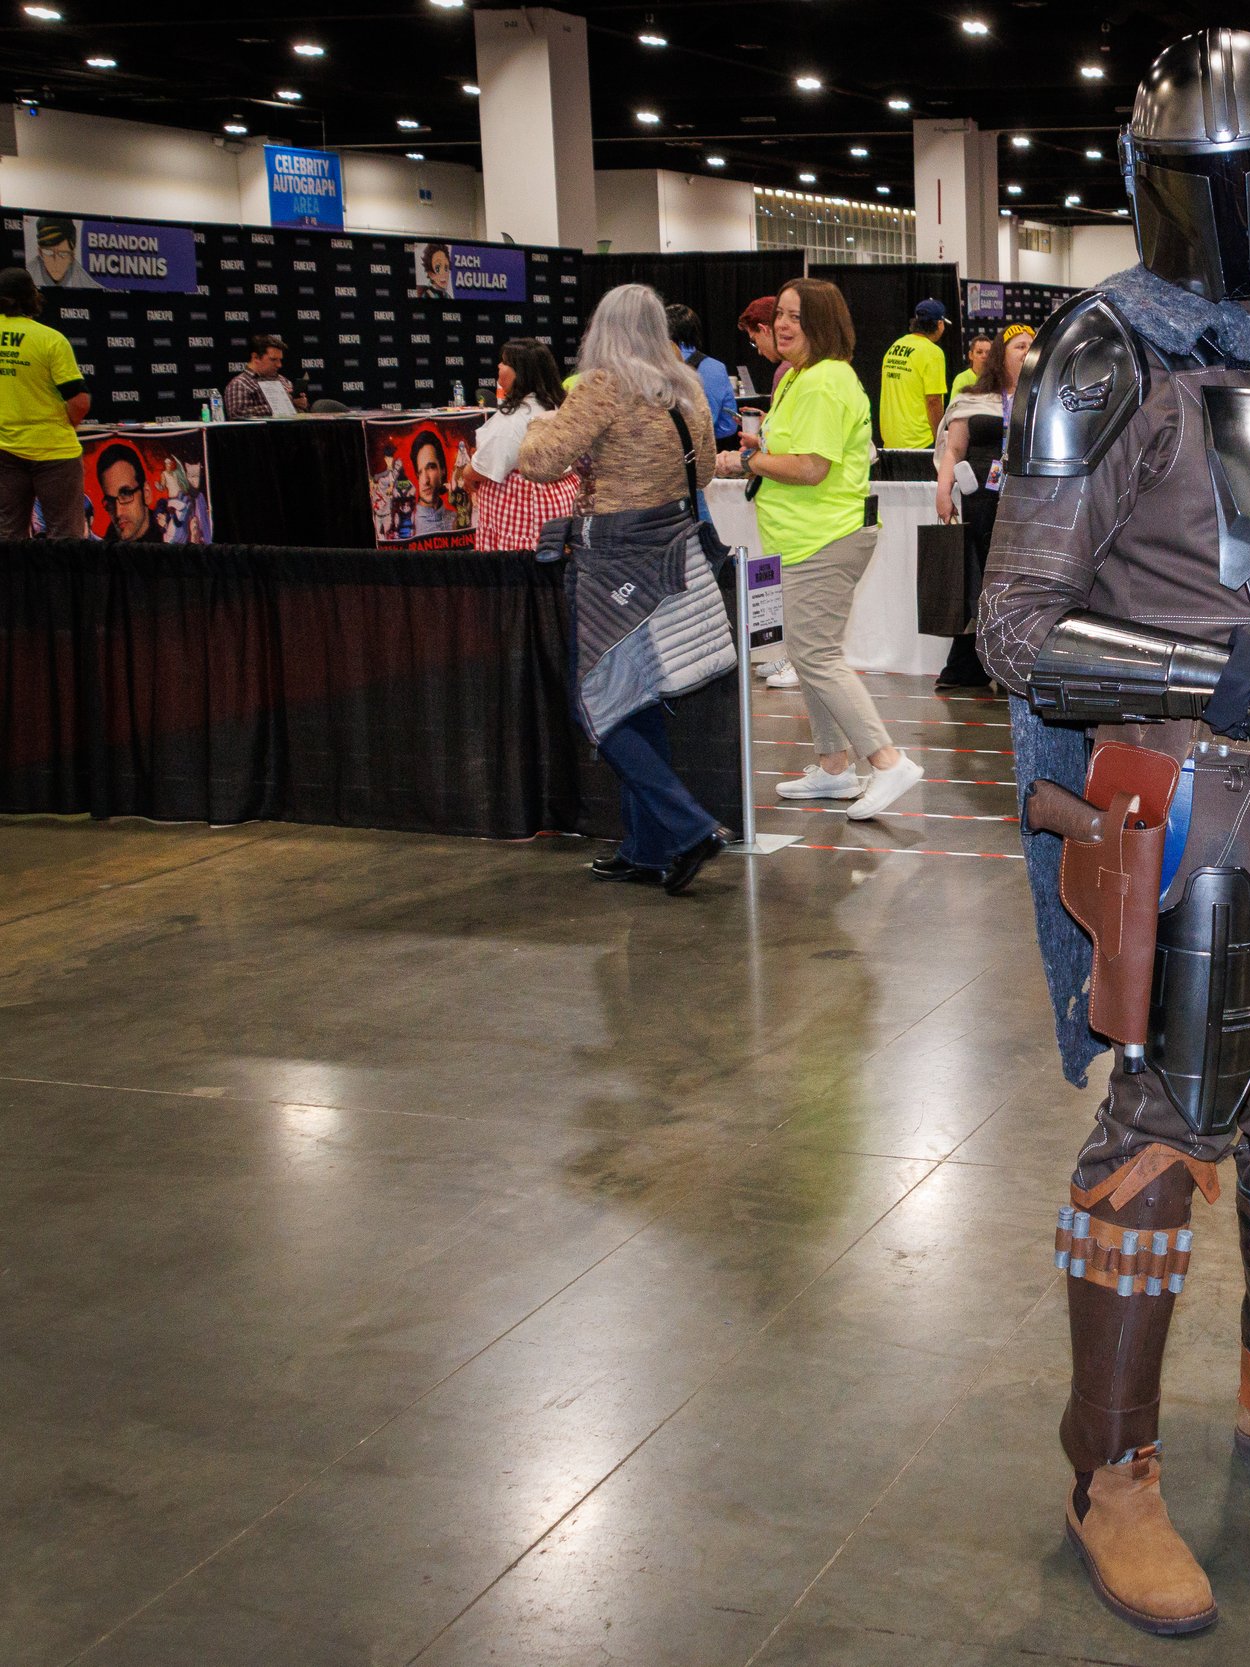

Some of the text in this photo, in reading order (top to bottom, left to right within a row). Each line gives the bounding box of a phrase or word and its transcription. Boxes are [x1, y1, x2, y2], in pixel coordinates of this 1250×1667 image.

[275, 154, 329, 176] CELEBRITY
[273, 174, 336, 197] AUTOGRAPH
[293, 197, 320, 214] AREA
[4, 218, 23, 230] FANE
[87, 232, 159, 252] BRANDON
[89, 253, 168, 277] MCINNIS
[454, 254, 481, 268] ZACH
[455, 271, 507, 289] AGUILAR
[407, 288, 418, 298] FANE
[60, 307, 90, 320] FANEXPO
[146, 310, 173, 322] FANEXPO
[224, 311, 249, 322] FANEXPO
[297, 310, 320, 321] FANEXPO
[0, 331, 25, 347] EW
[107, 336, 135, 348] FANEXPO
[188, 336, 214, 348] FANEXPO
[151, 363, 178, 374] FANEXPO
[228, 362, 248, 373] FANEX
[301, 358, 325, 369] FANEXPO
[77, 364, 95, 376] EXPO
[112, 390, 139, 402] FANEXPO
